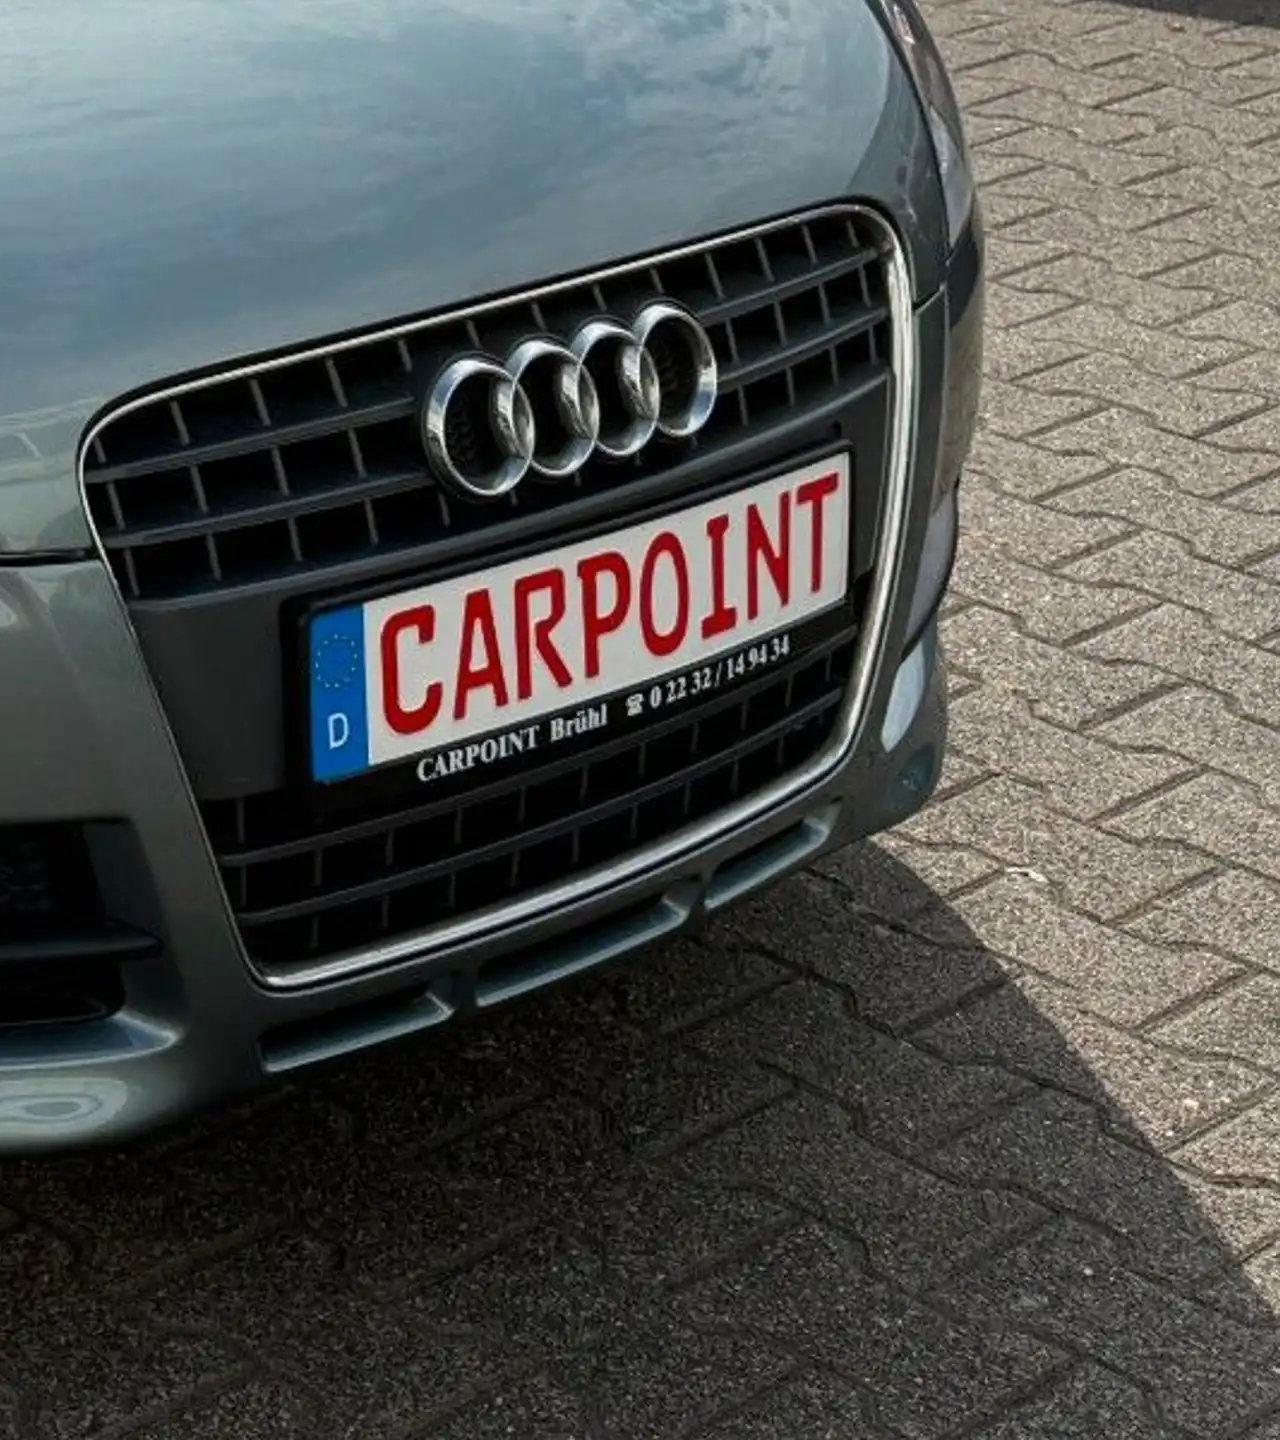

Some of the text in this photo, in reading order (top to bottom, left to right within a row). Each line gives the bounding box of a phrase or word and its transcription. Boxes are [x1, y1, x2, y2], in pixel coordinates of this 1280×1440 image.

[380, 471, 839, 736] CARPOINT
[328, 712, 349, 750] D
[416, 725, 540, 782] CARPOINT
[550, 703, 608, 742] Brühl
